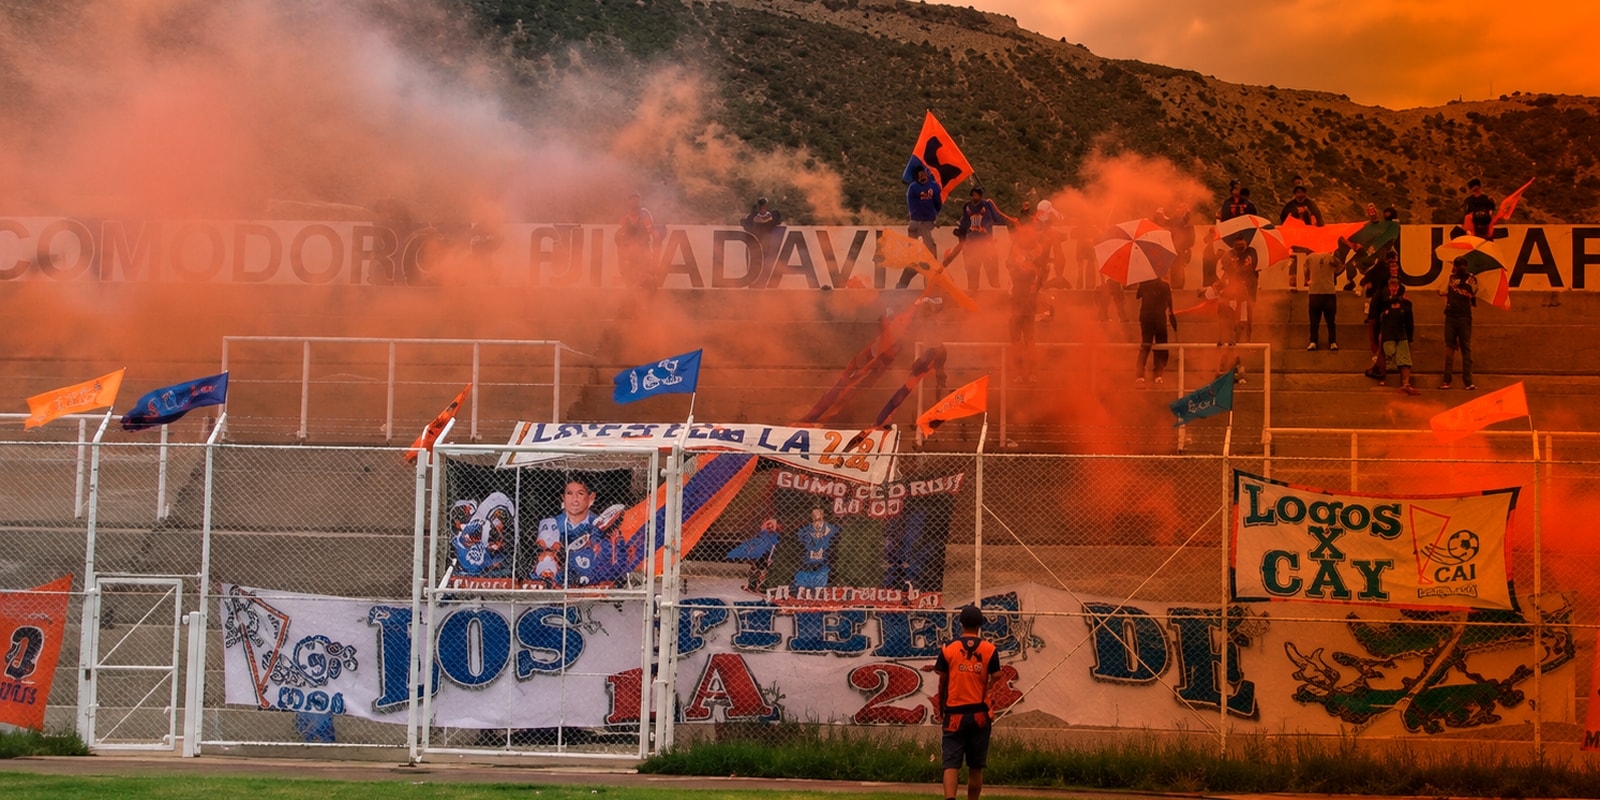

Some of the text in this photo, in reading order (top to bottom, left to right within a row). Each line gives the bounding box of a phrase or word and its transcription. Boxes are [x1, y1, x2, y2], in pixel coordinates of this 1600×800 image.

[1307, 525, 1346, 561] X
[1260, 549, 1395, 599] CAY
[1434, 563, 1476, 583] CAI
